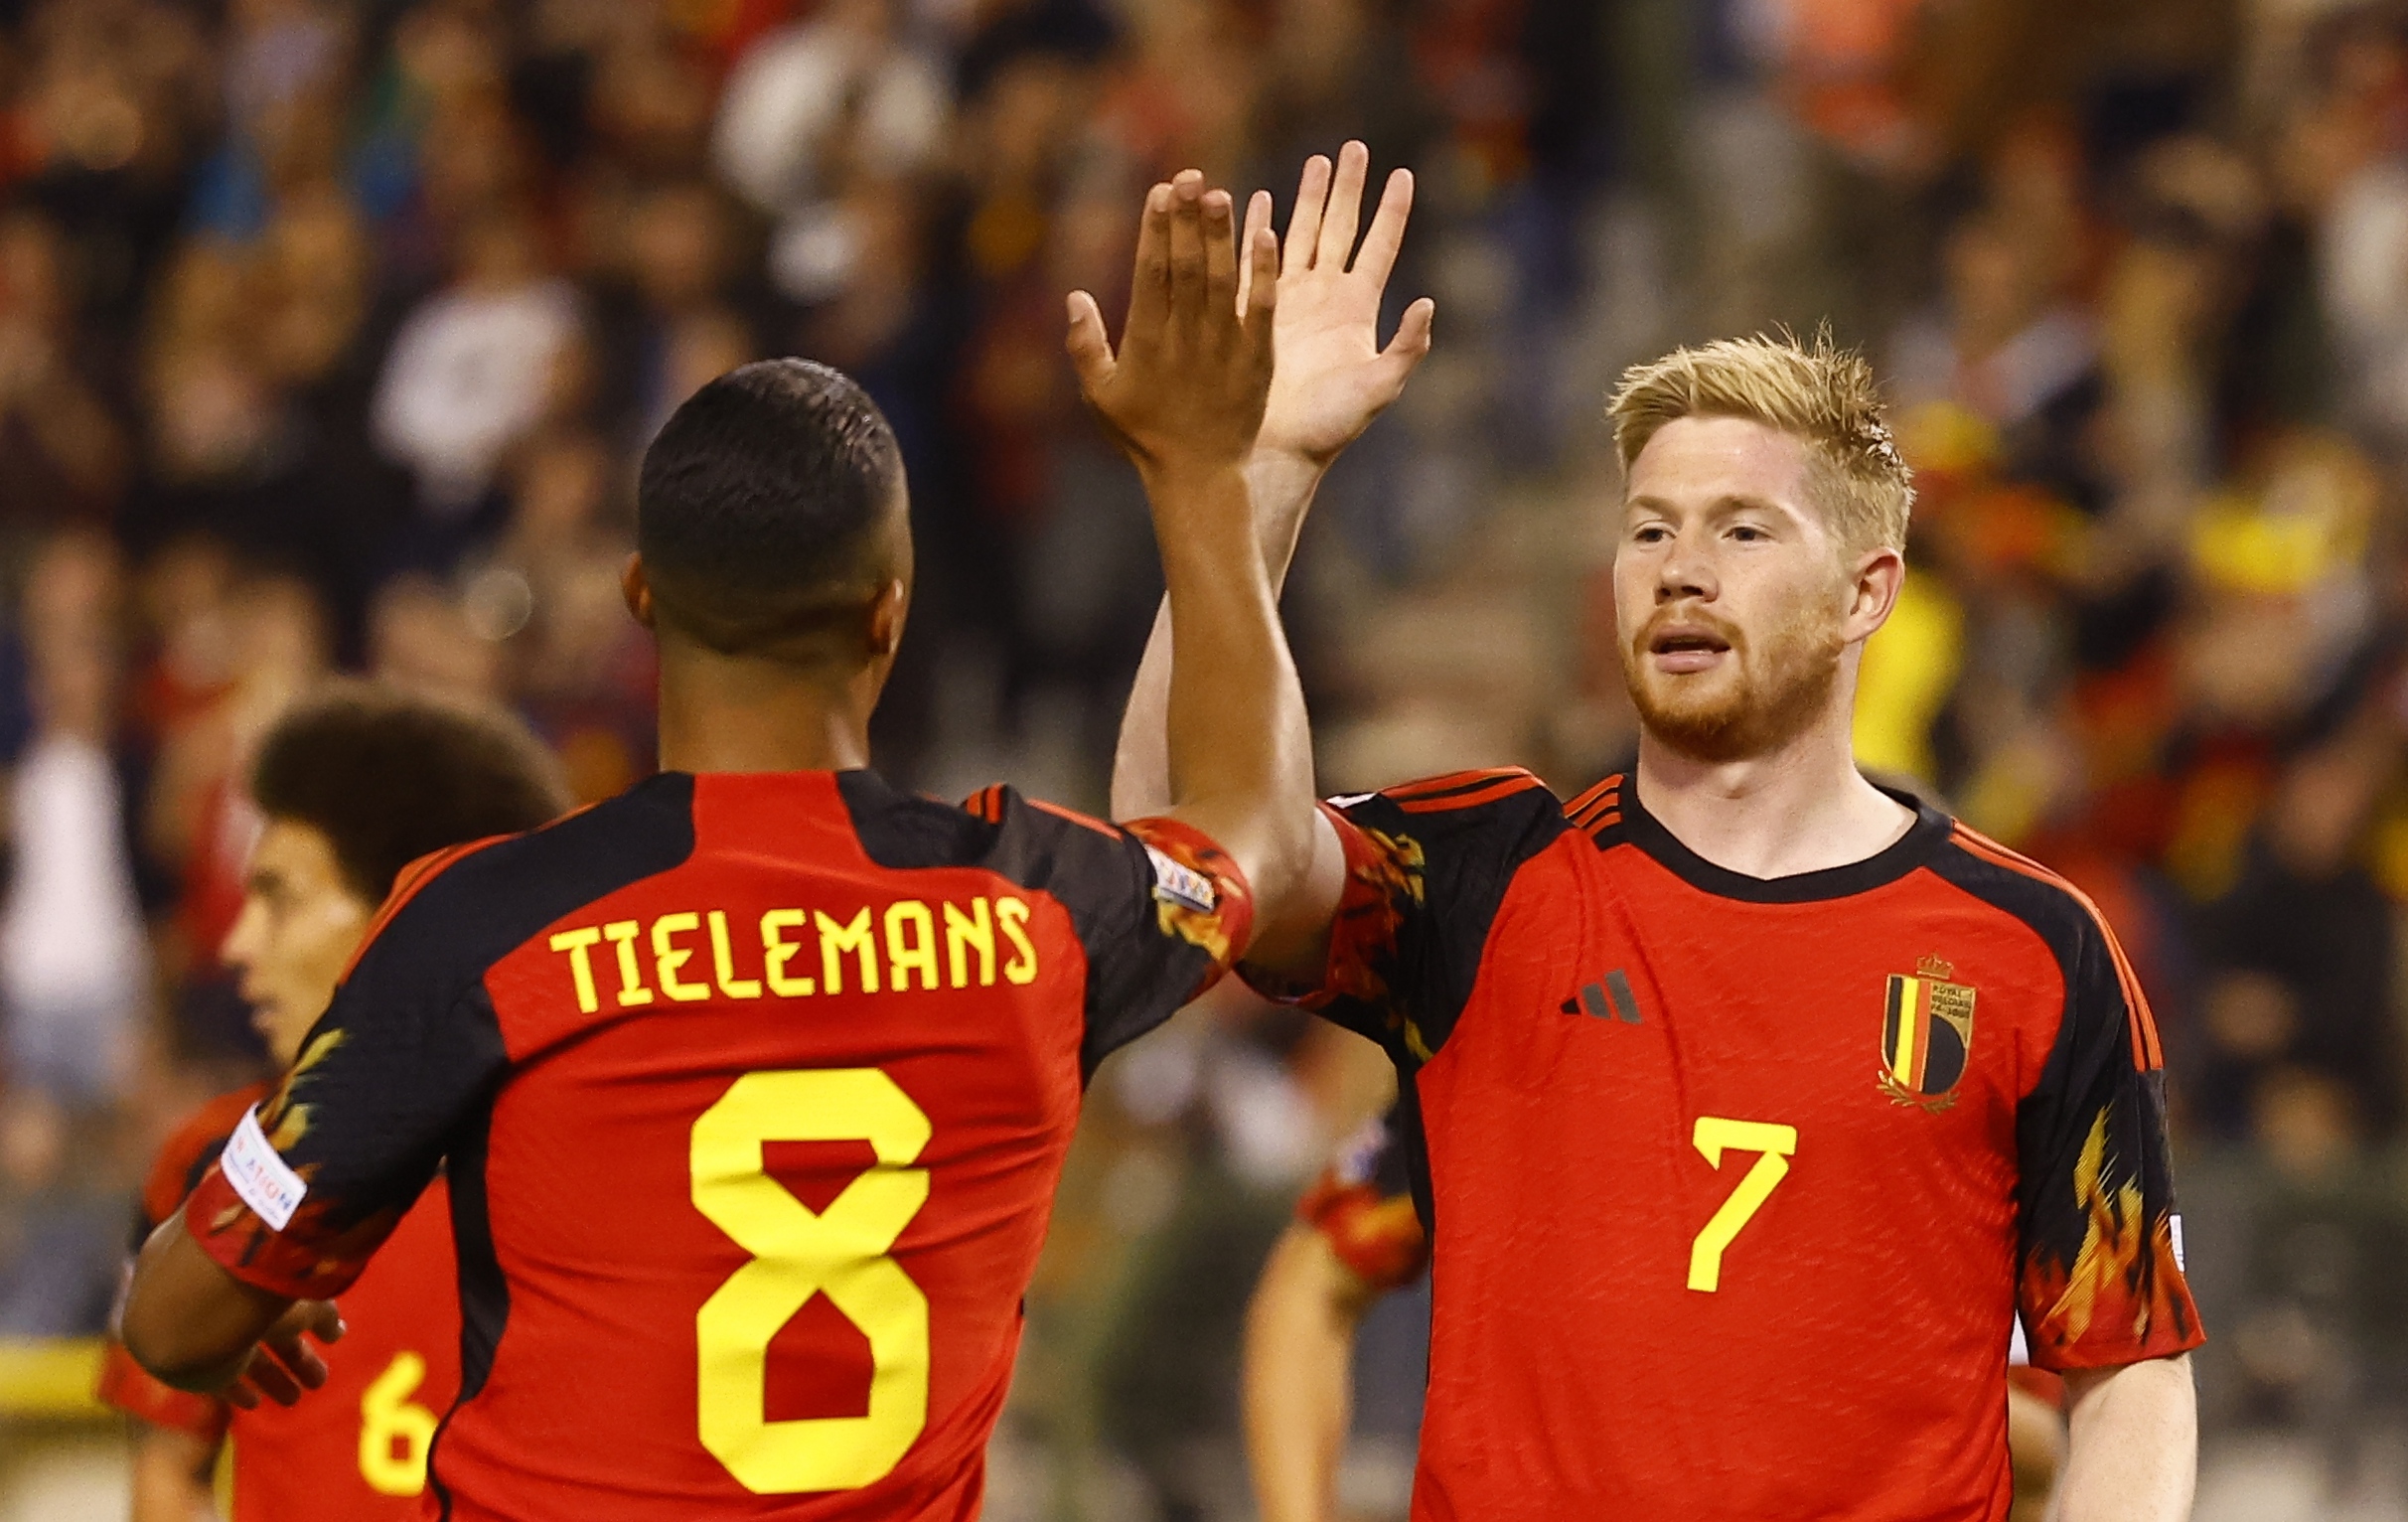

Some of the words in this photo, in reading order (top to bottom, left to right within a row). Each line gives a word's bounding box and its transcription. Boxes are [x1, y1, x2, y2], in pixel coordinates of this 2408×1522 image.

[548, 895, 1039, 1014] TIELEMANS
[689, 1068, 932, 1494] 8
[1688, 1116, 1797, 1293] 7
[359, 1350, 440, 1497] 6
